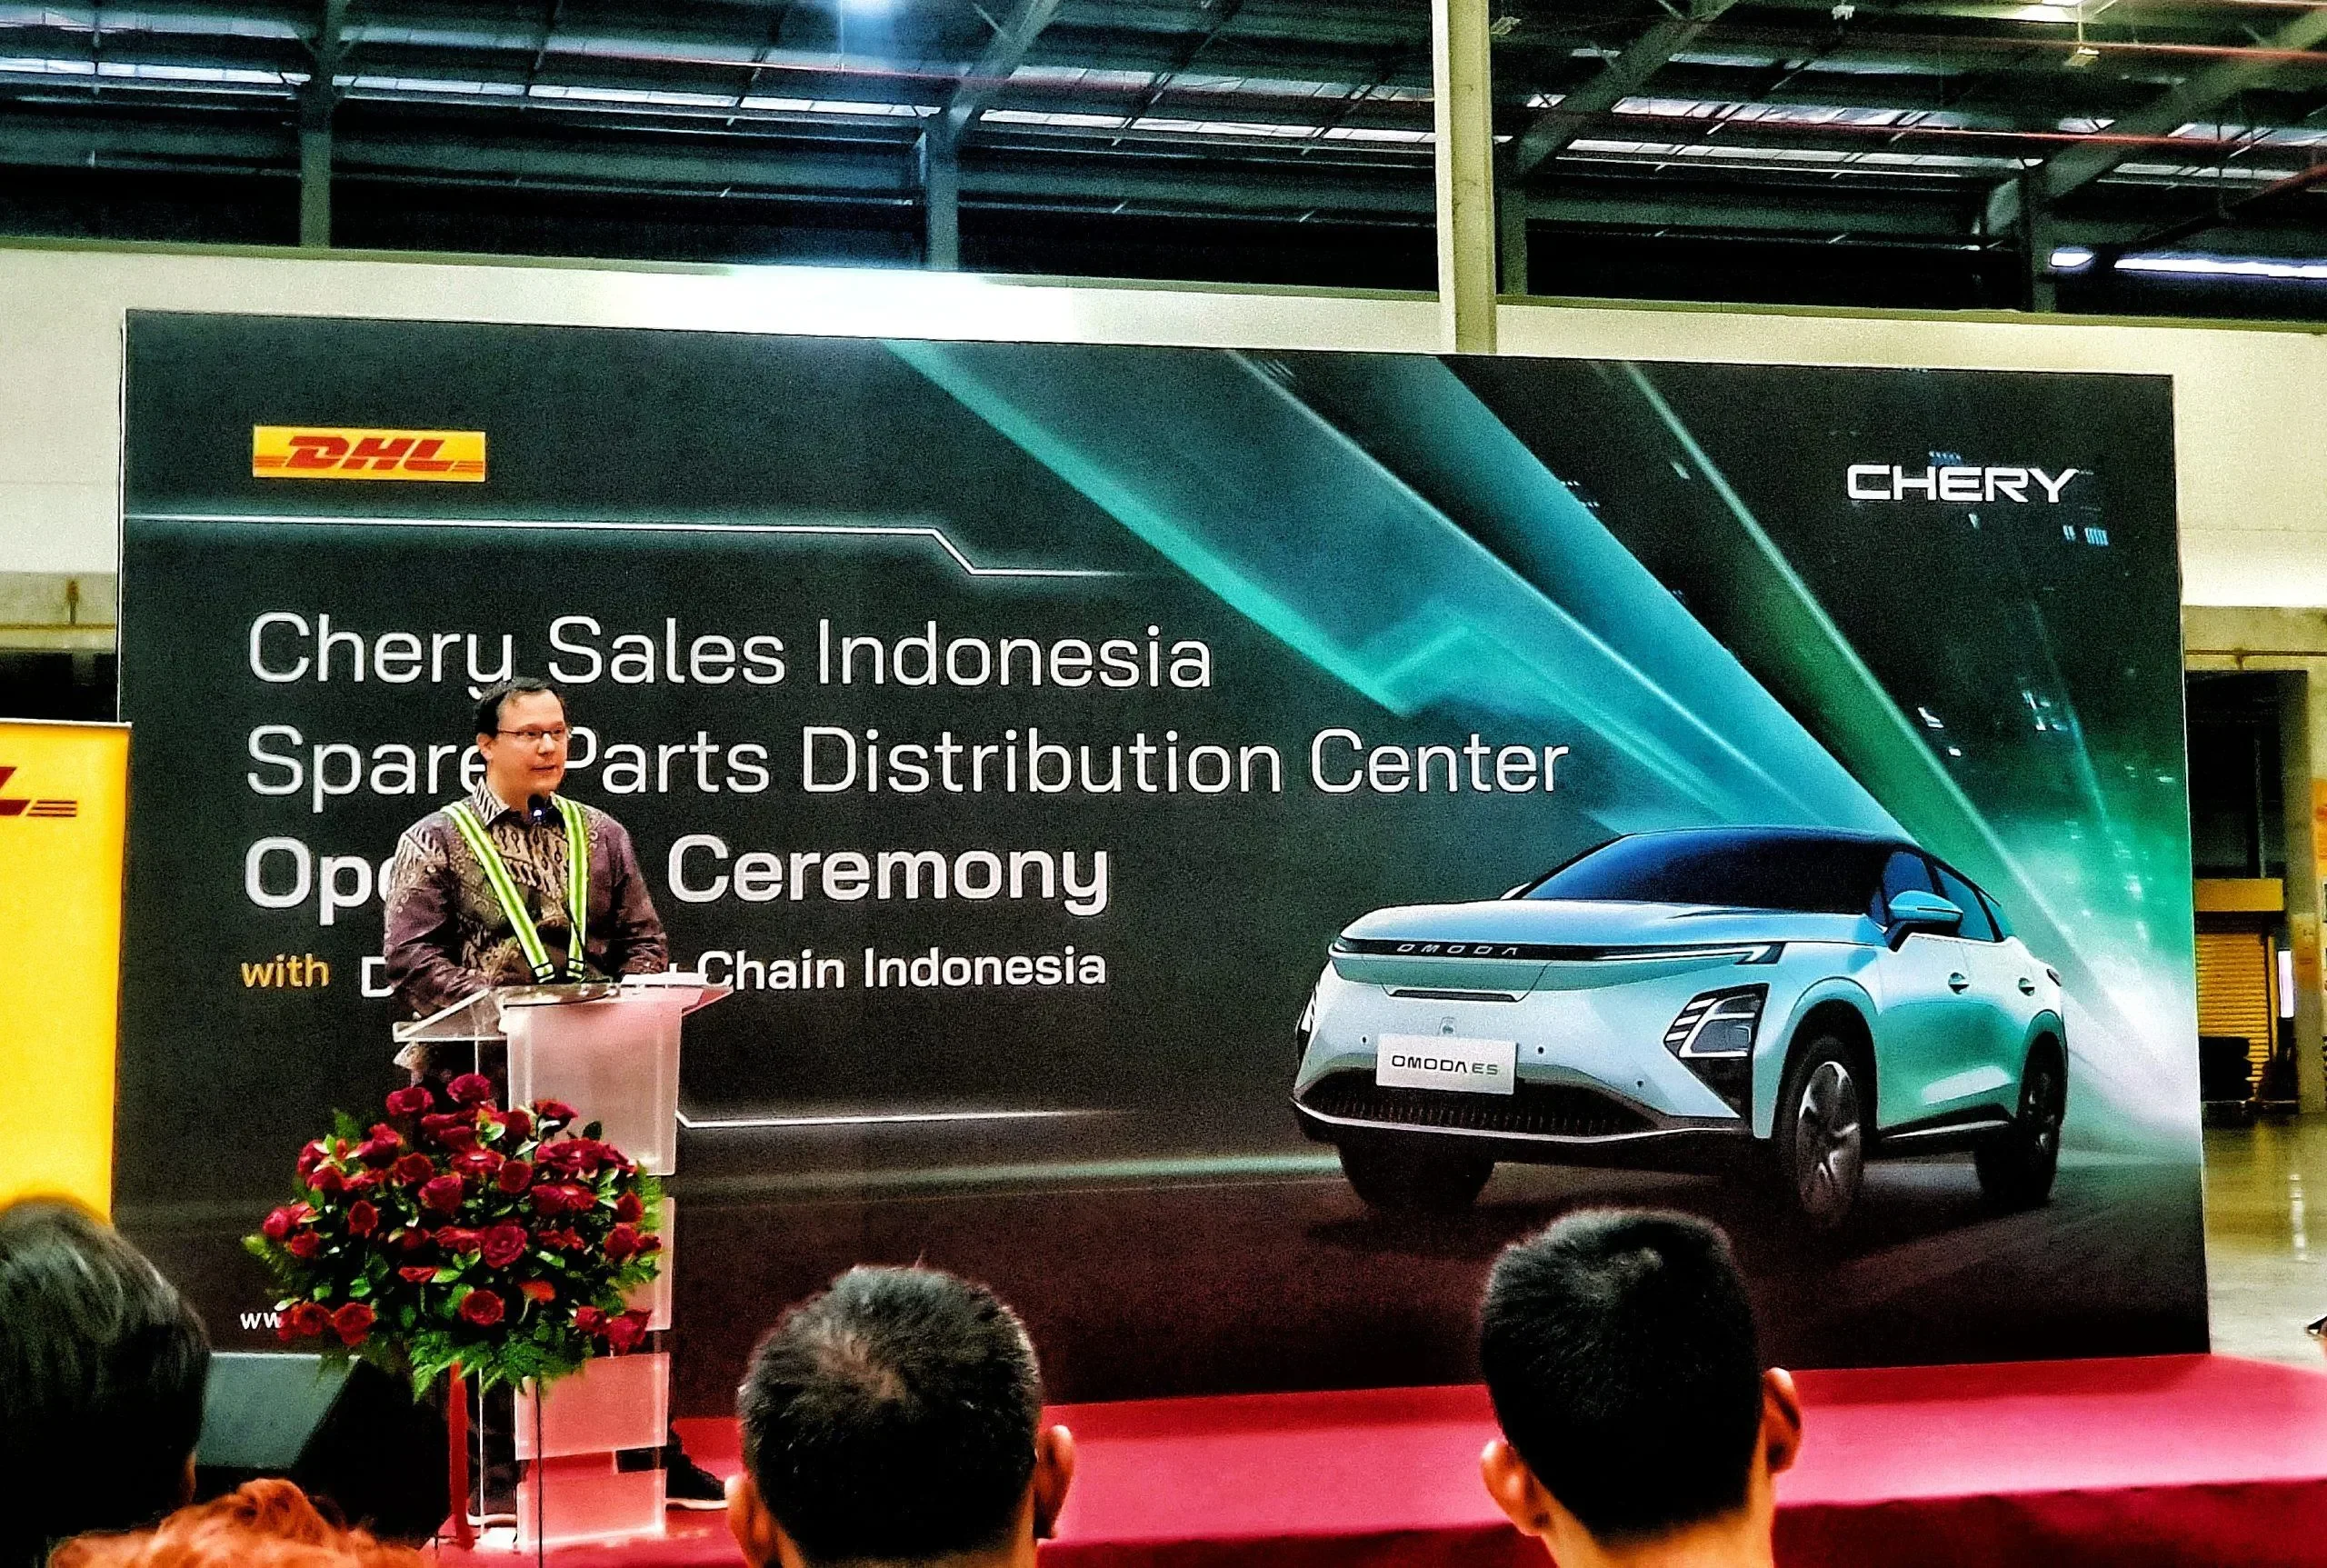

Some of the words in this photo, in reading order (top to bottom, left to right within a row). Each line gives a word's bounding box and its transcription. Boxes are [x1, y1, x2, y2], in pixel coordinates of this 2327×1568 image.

[288, 436, 454, 472] DHL
[1846, 464, 2080, 504] CHERY
[248, 612, 514, 699] Chery
[547, 615, 786, 685] Sales
[819, 618, 1212, 689] Indonesia
[246, 724, 486, 814] Spare
[565, 726, 771, 794] Parts
[802, 724, 1282, 794] Distribution
[1311, 728, 1570, 794] Center
[667, 833, 1109, 917] Ceremony
[241, 953, 330, 988] with
[697, 949, 845, 991] Chain
[864, 945, 1107, 989] Indonesia
[1396, 943, 1518, 956] OMODA
